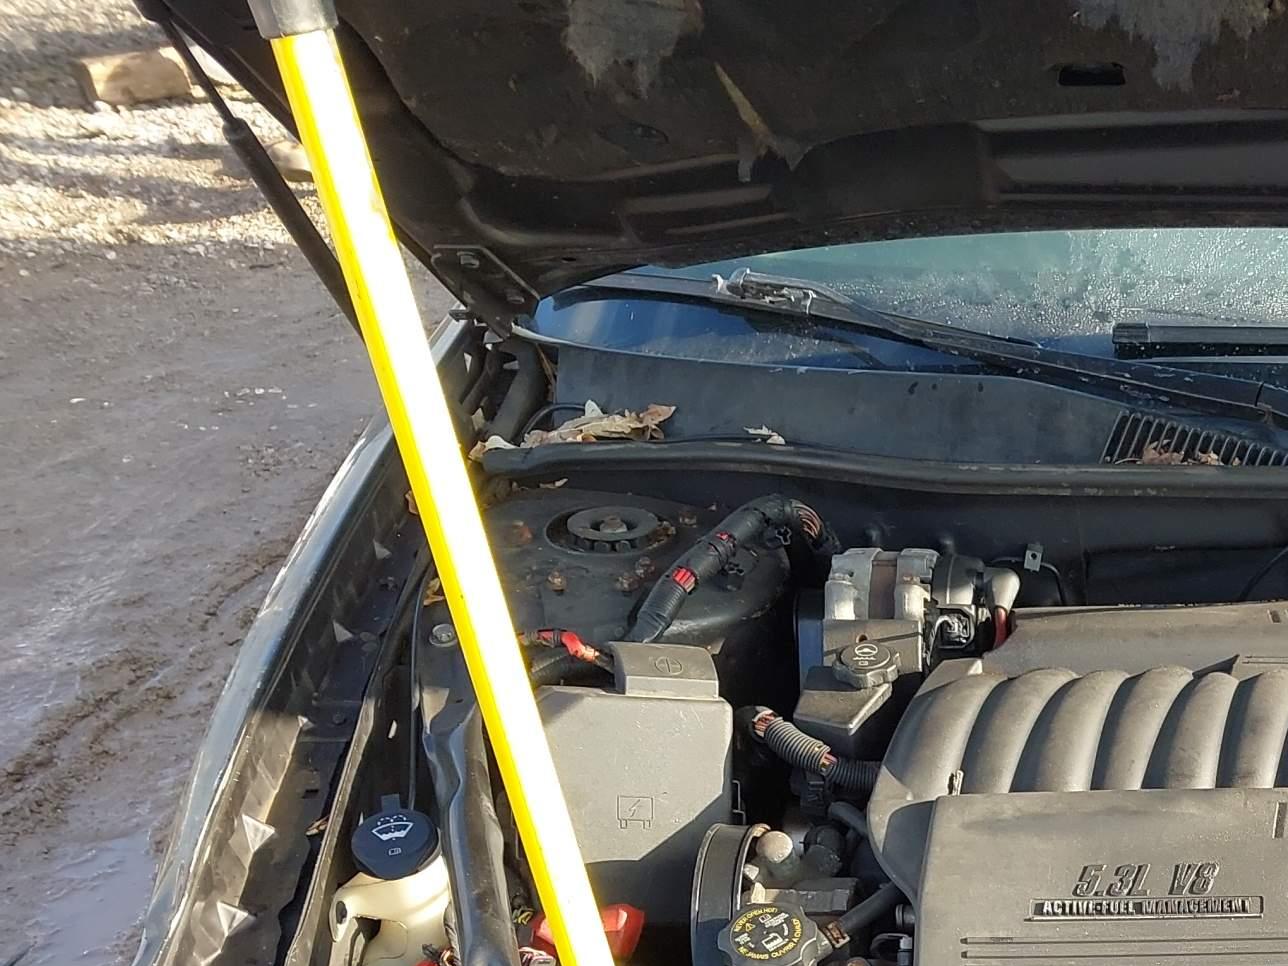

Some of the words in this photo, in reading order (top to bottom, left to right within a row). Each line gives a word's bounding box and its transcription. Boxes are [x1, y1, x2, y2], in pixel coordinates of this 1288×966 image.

[1071, 864, 1150, 897] 5.3L
[1168, 863, 1220, 895] V8
[1142, 898, 1251, 915] MANAGEMENT
